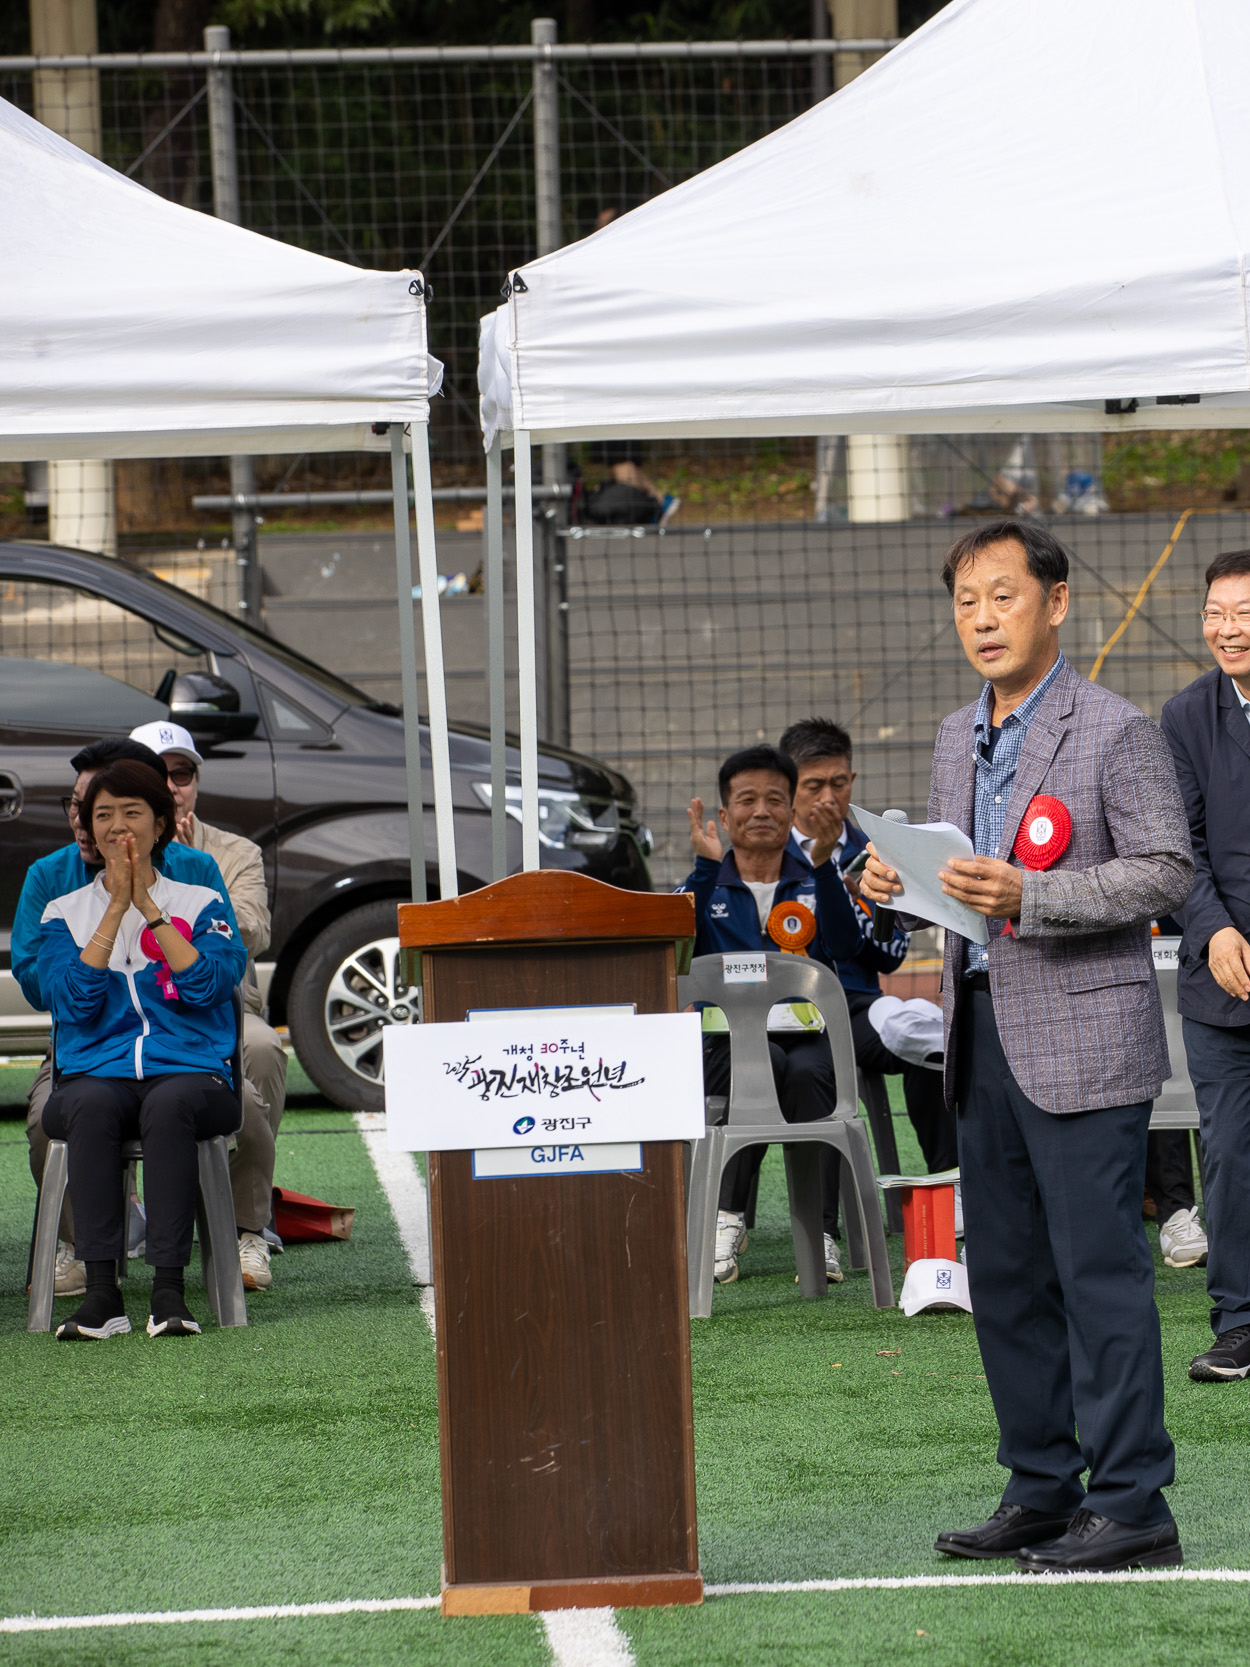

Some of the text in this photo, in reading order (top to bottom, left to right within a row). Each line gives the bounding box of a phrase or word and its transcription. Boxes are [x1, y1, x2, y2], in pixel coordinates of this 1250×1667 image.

[725, 963, 766, 974] 광진구청장
[502, 1038, 585, 1062] 개청 30주년
[443, 1055, 482, 1082] 2025
[541, 1117, 592, 1132] 광진구
[531, 1145, 585, 1163] GJFA
